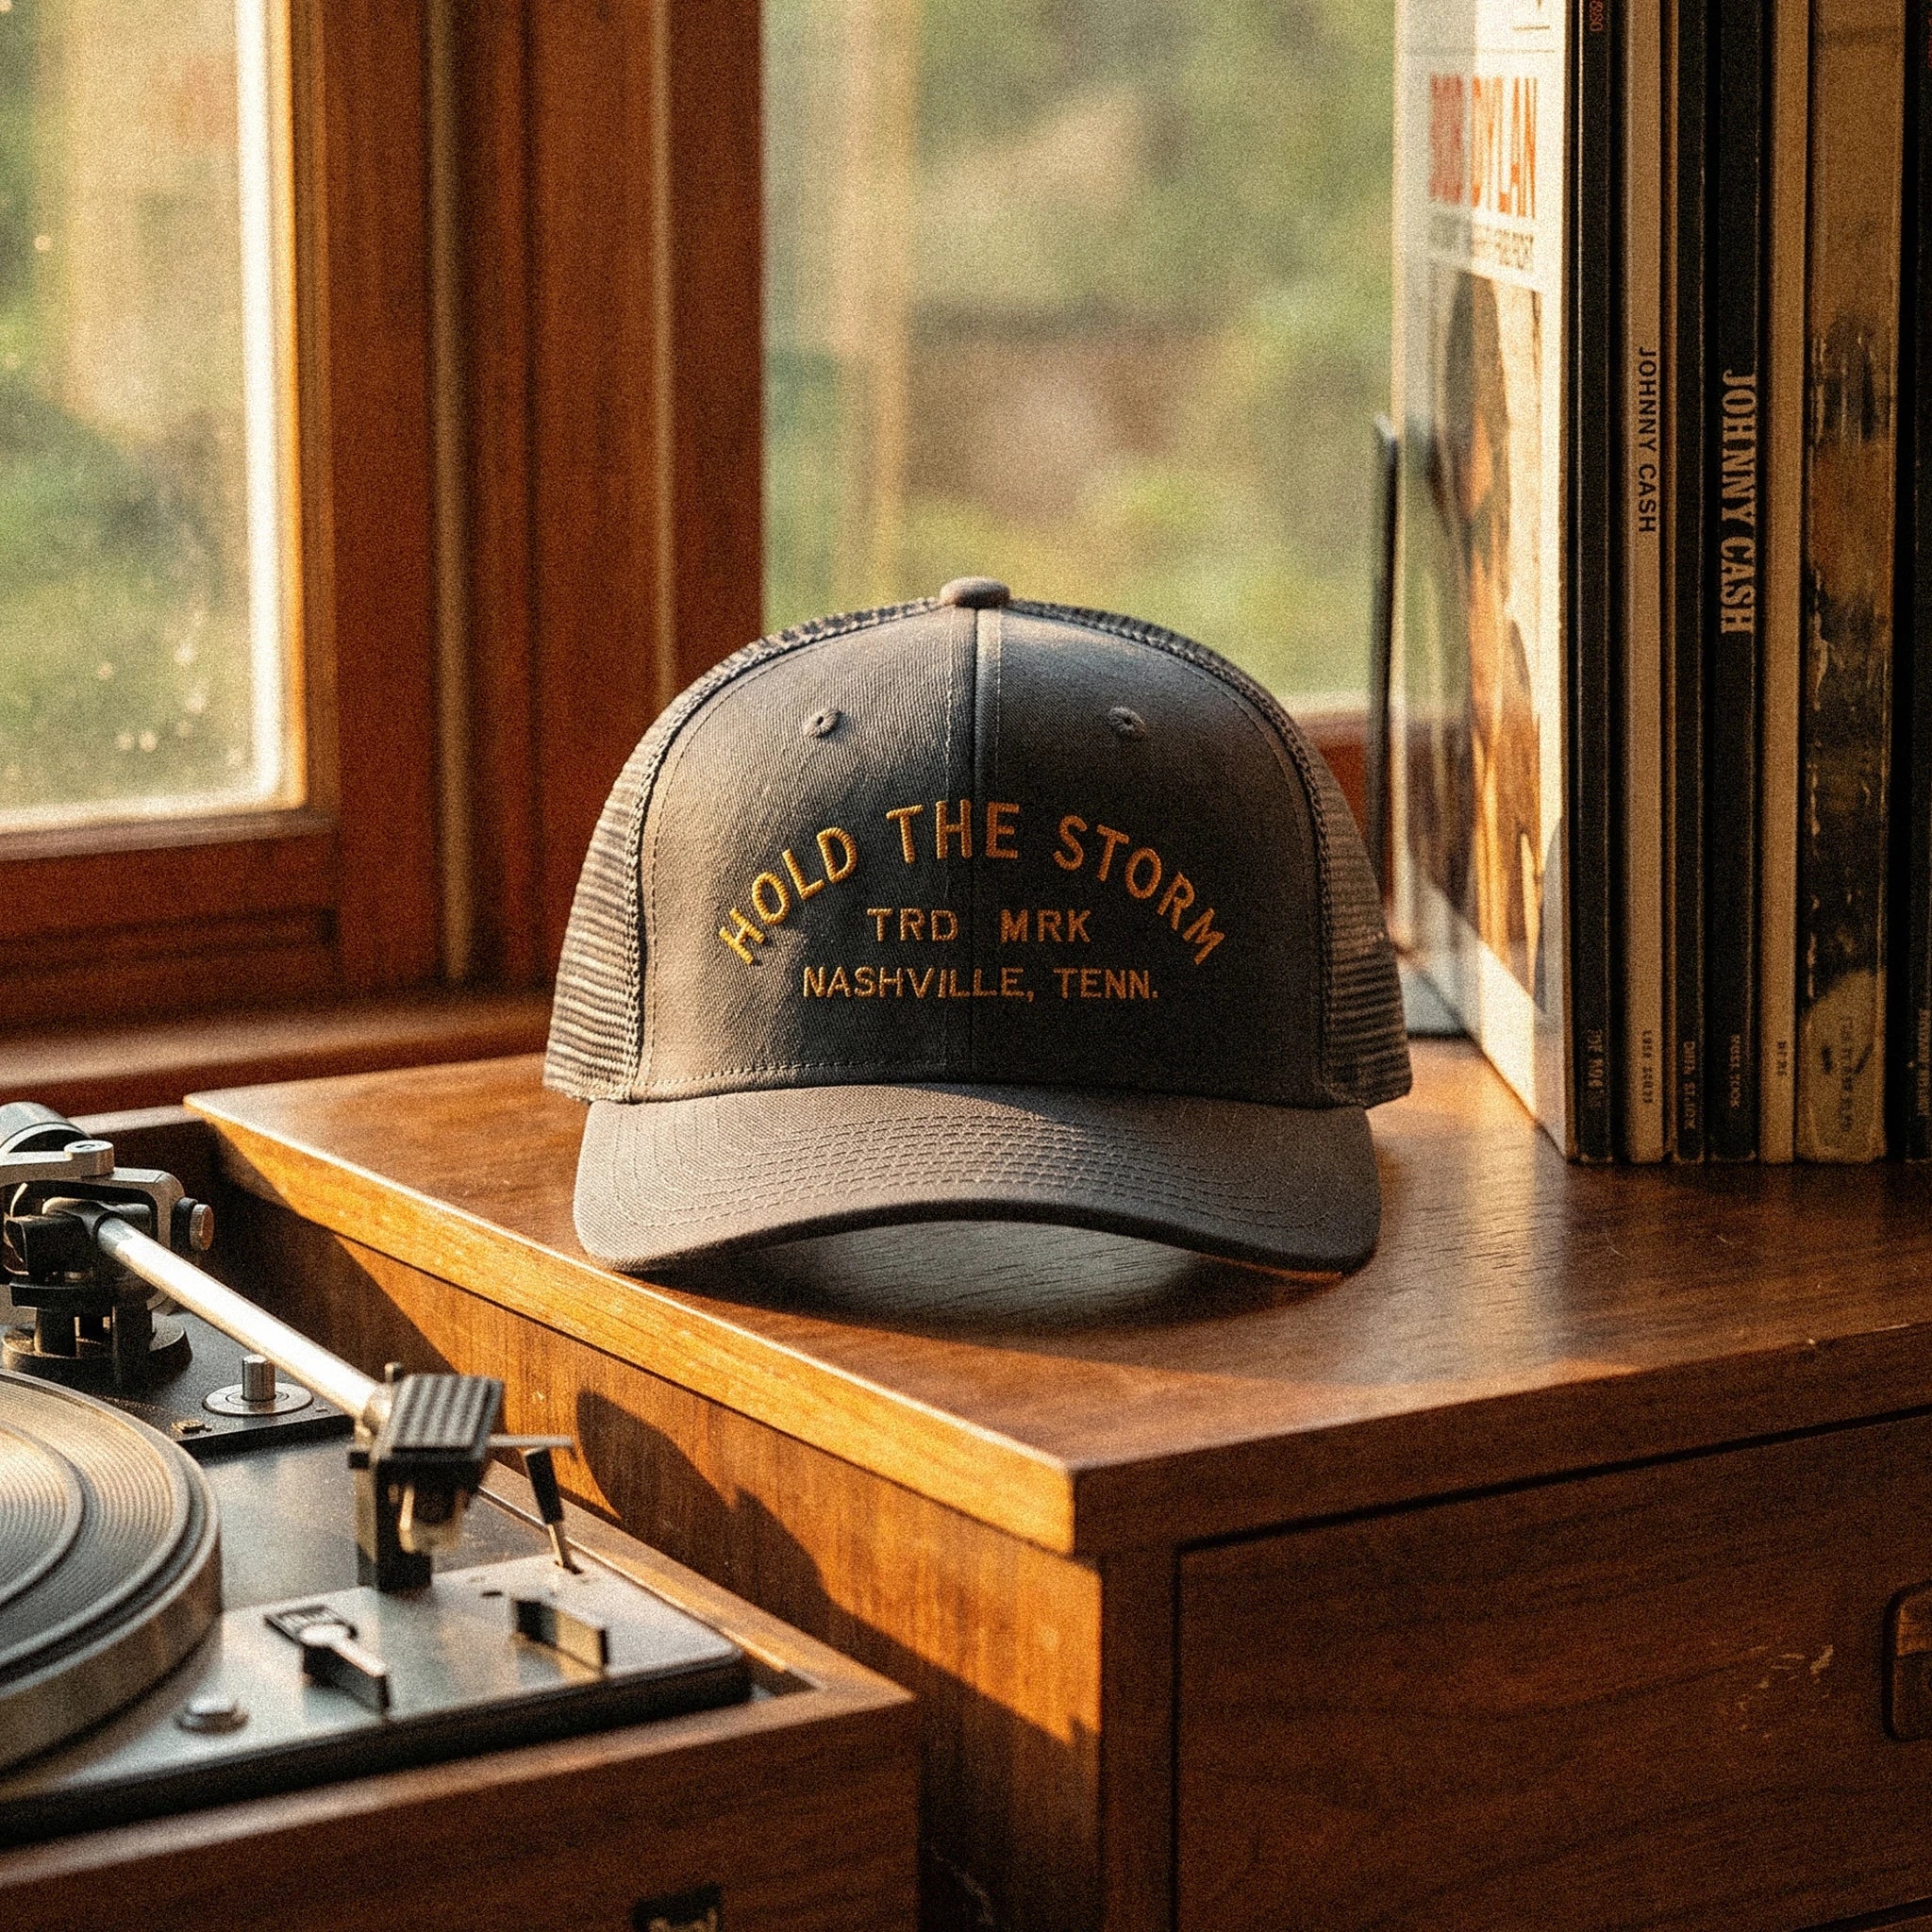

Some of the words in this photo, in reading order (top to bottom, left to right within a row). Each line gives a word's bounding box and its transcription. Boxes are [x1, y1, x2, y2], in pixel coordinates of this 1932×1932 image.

[1638, 346, 1657, 453] JOHNNY
[1721, 369, 1757, 525] JOHNNY
[1638, 463, 1657, 533] CASH
[1720, 536, 1757, 636] CASH
[718, 826, 858, 965] HOLD
[886, 799, 1021, 864] THE
[1053, 815, 1225, 965] STORM
[866, 908, 958, 942] TRD
[1000, 908, 1091, 943] MRK
[803, 966, 1035, 1003] NASHVILLE,
[1053, 967, 1159, 1000] TENN.
